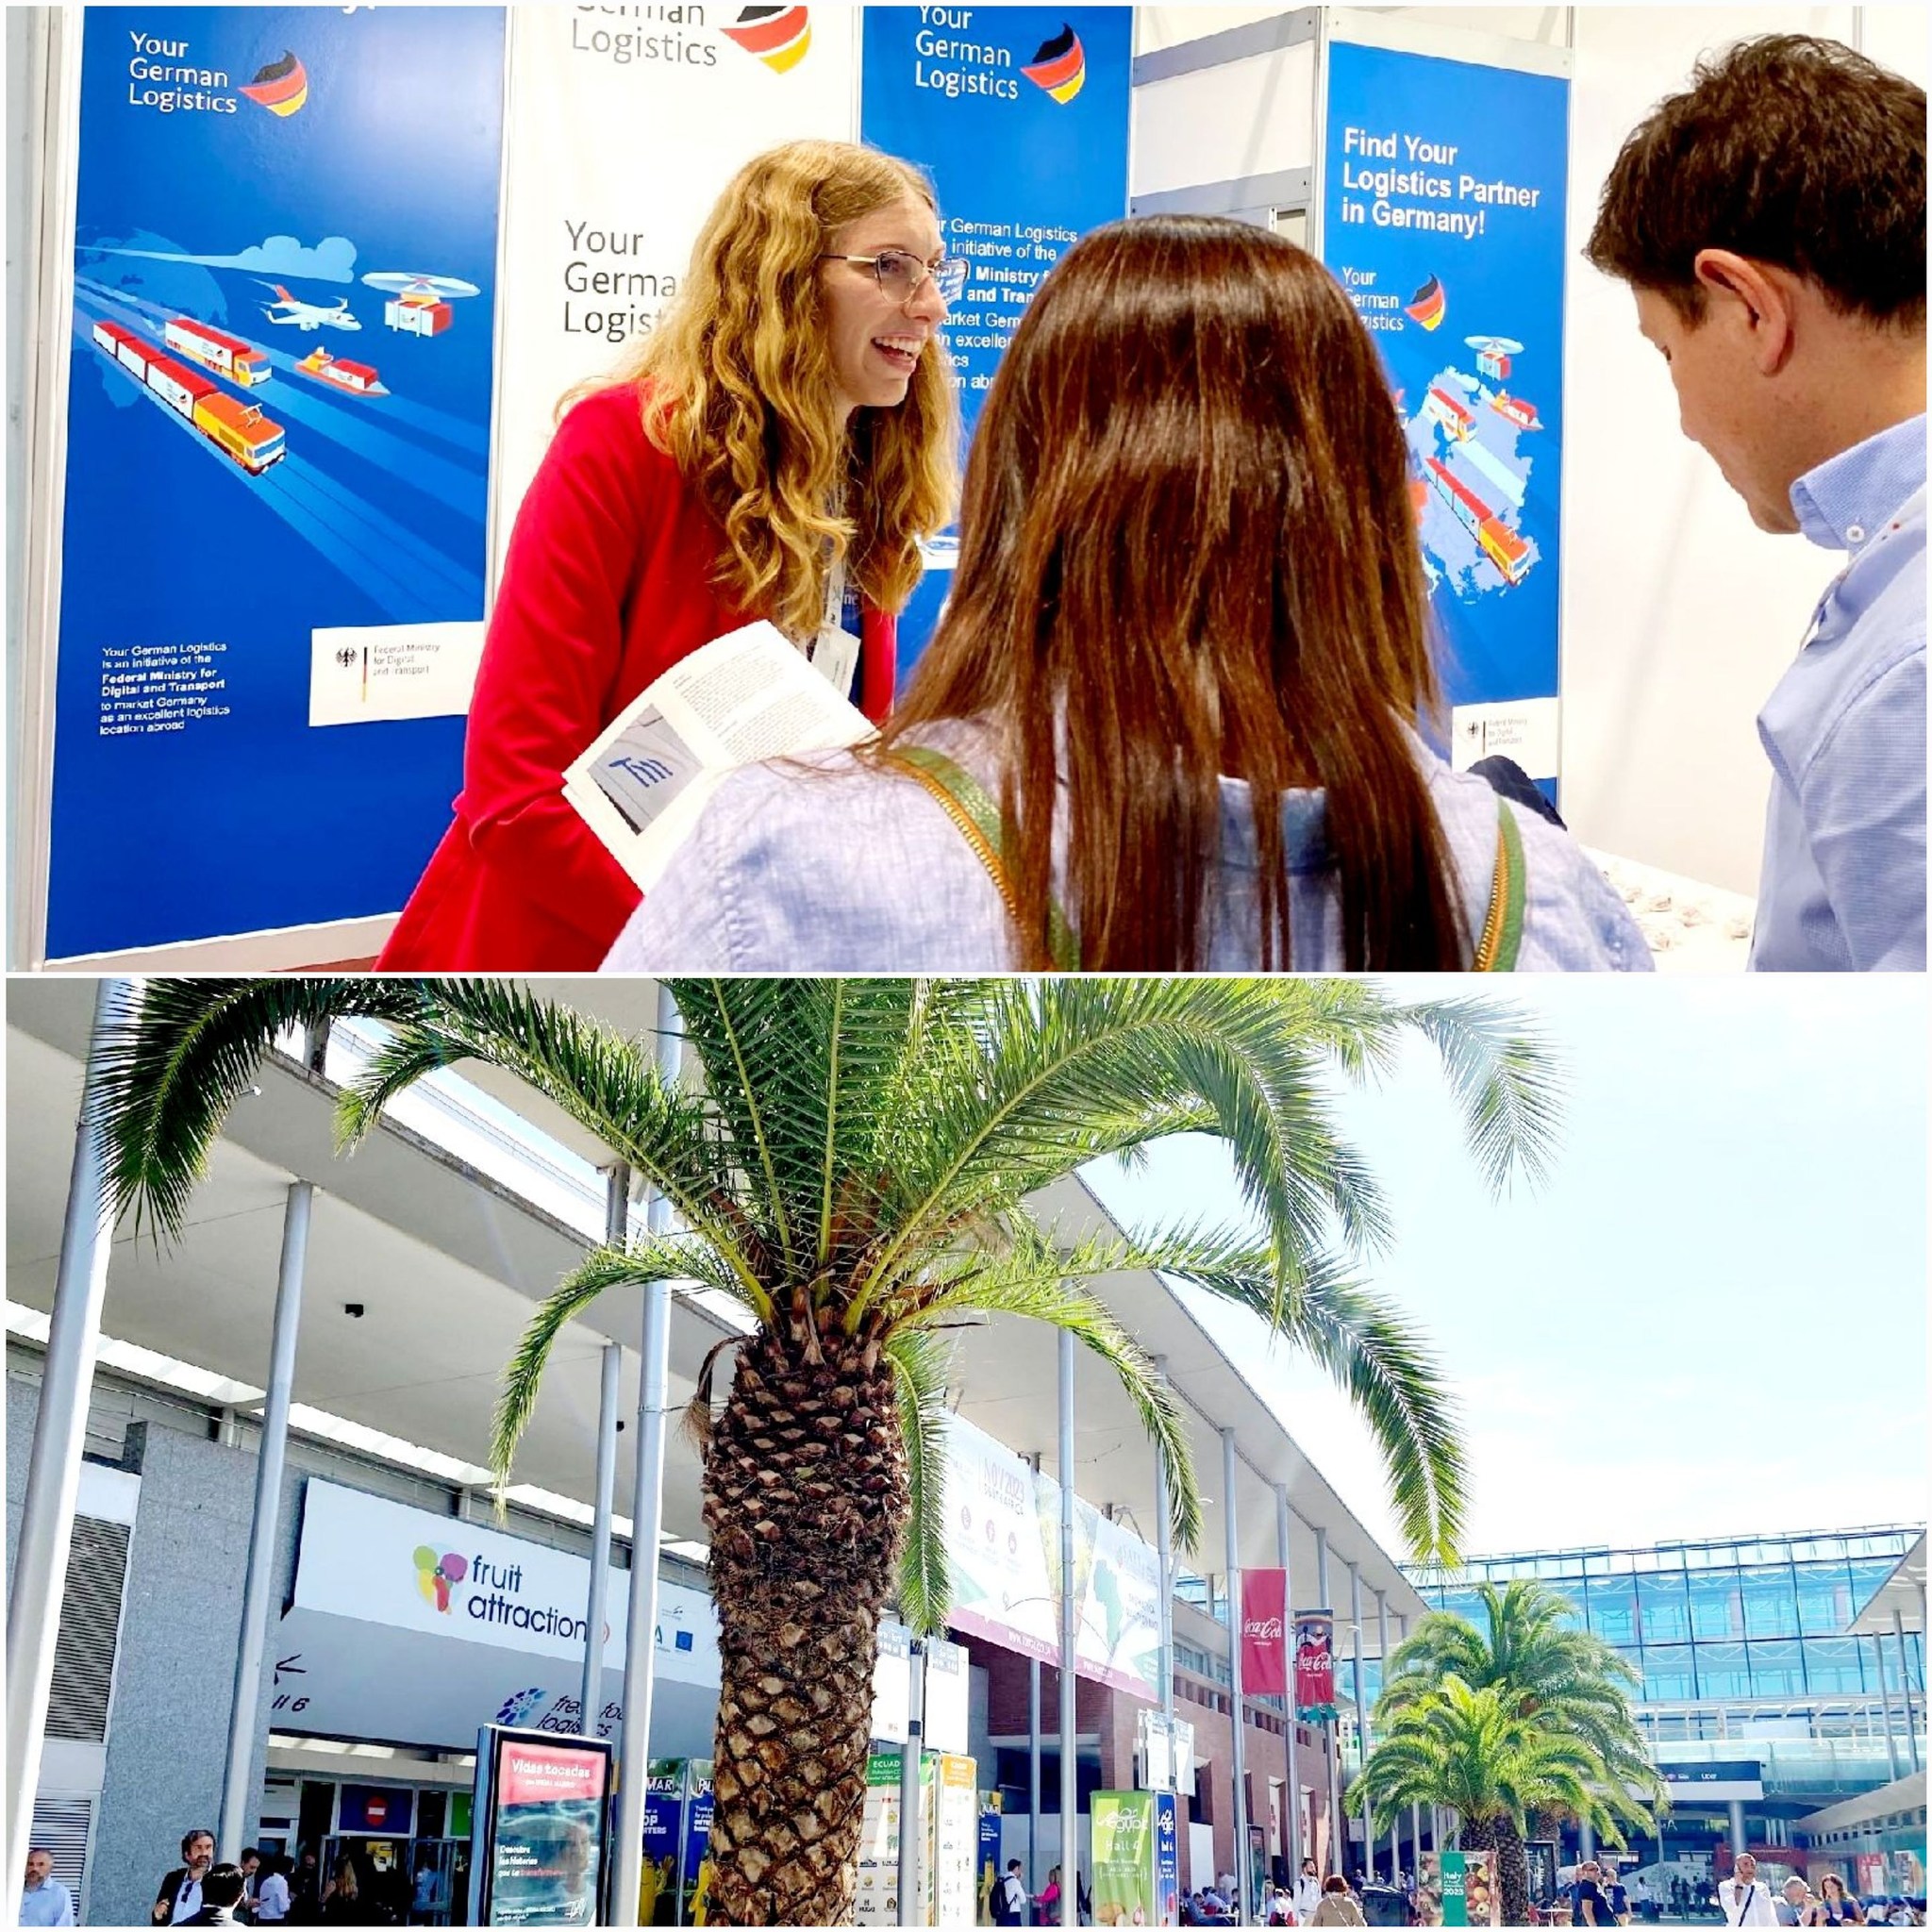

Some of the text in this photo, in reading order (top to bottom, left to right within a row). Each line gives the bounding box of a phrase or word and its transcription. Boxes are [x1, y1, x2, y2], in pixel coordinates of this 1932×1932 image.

[920, 6, 973, 29] Your
[129, 30, 190, 58] Your
[572, 18, 717, 66] Logistics
[916, 29, 1011, 68] German
[129, 57, 228, 88] German
[916, 60, 1019, 100] Logistics
[129, 82, 238, 114] Logistics
[1343, 126, 1458, 166] Find Your
[1342, 161, 1541, 208] Logistics Partner
[951, 218, 1011, 237] German
[1015, 223, 1078, 242] Logistics
[1341, 196, 1486, 241] in Germany!
[564, 220, 644, 256] Your
[952, 239, 1057, 260] initiative of the
[564, 261, 677, 297] Germa
[975, 266, 1040, 288] Ministry
[1341, 266, 1377, 286] Your
[967, 288, 997, 303] and
[941, 313, 980, 326] arket
[102, 642, 227, 657] Your German Logistics
[102, 668, 218, 684] Federal Ministry for
[101, 679, 225, 698] Digital and Transport
[101, 703, 111, 711] to
[157, 697, 208, 707] Germany
[187, 706, 230, 718] logistics
[100, 724, 144, 736] location
[473, 1555, 523, 1593] fruit
[468, 1592, 588, 1642] attraction
[291, 1697, 310, 1712] 6
[511, 1758, 591, 1779] Vidas tocadas
[1443, 1888, 1464, 1896] 2023
